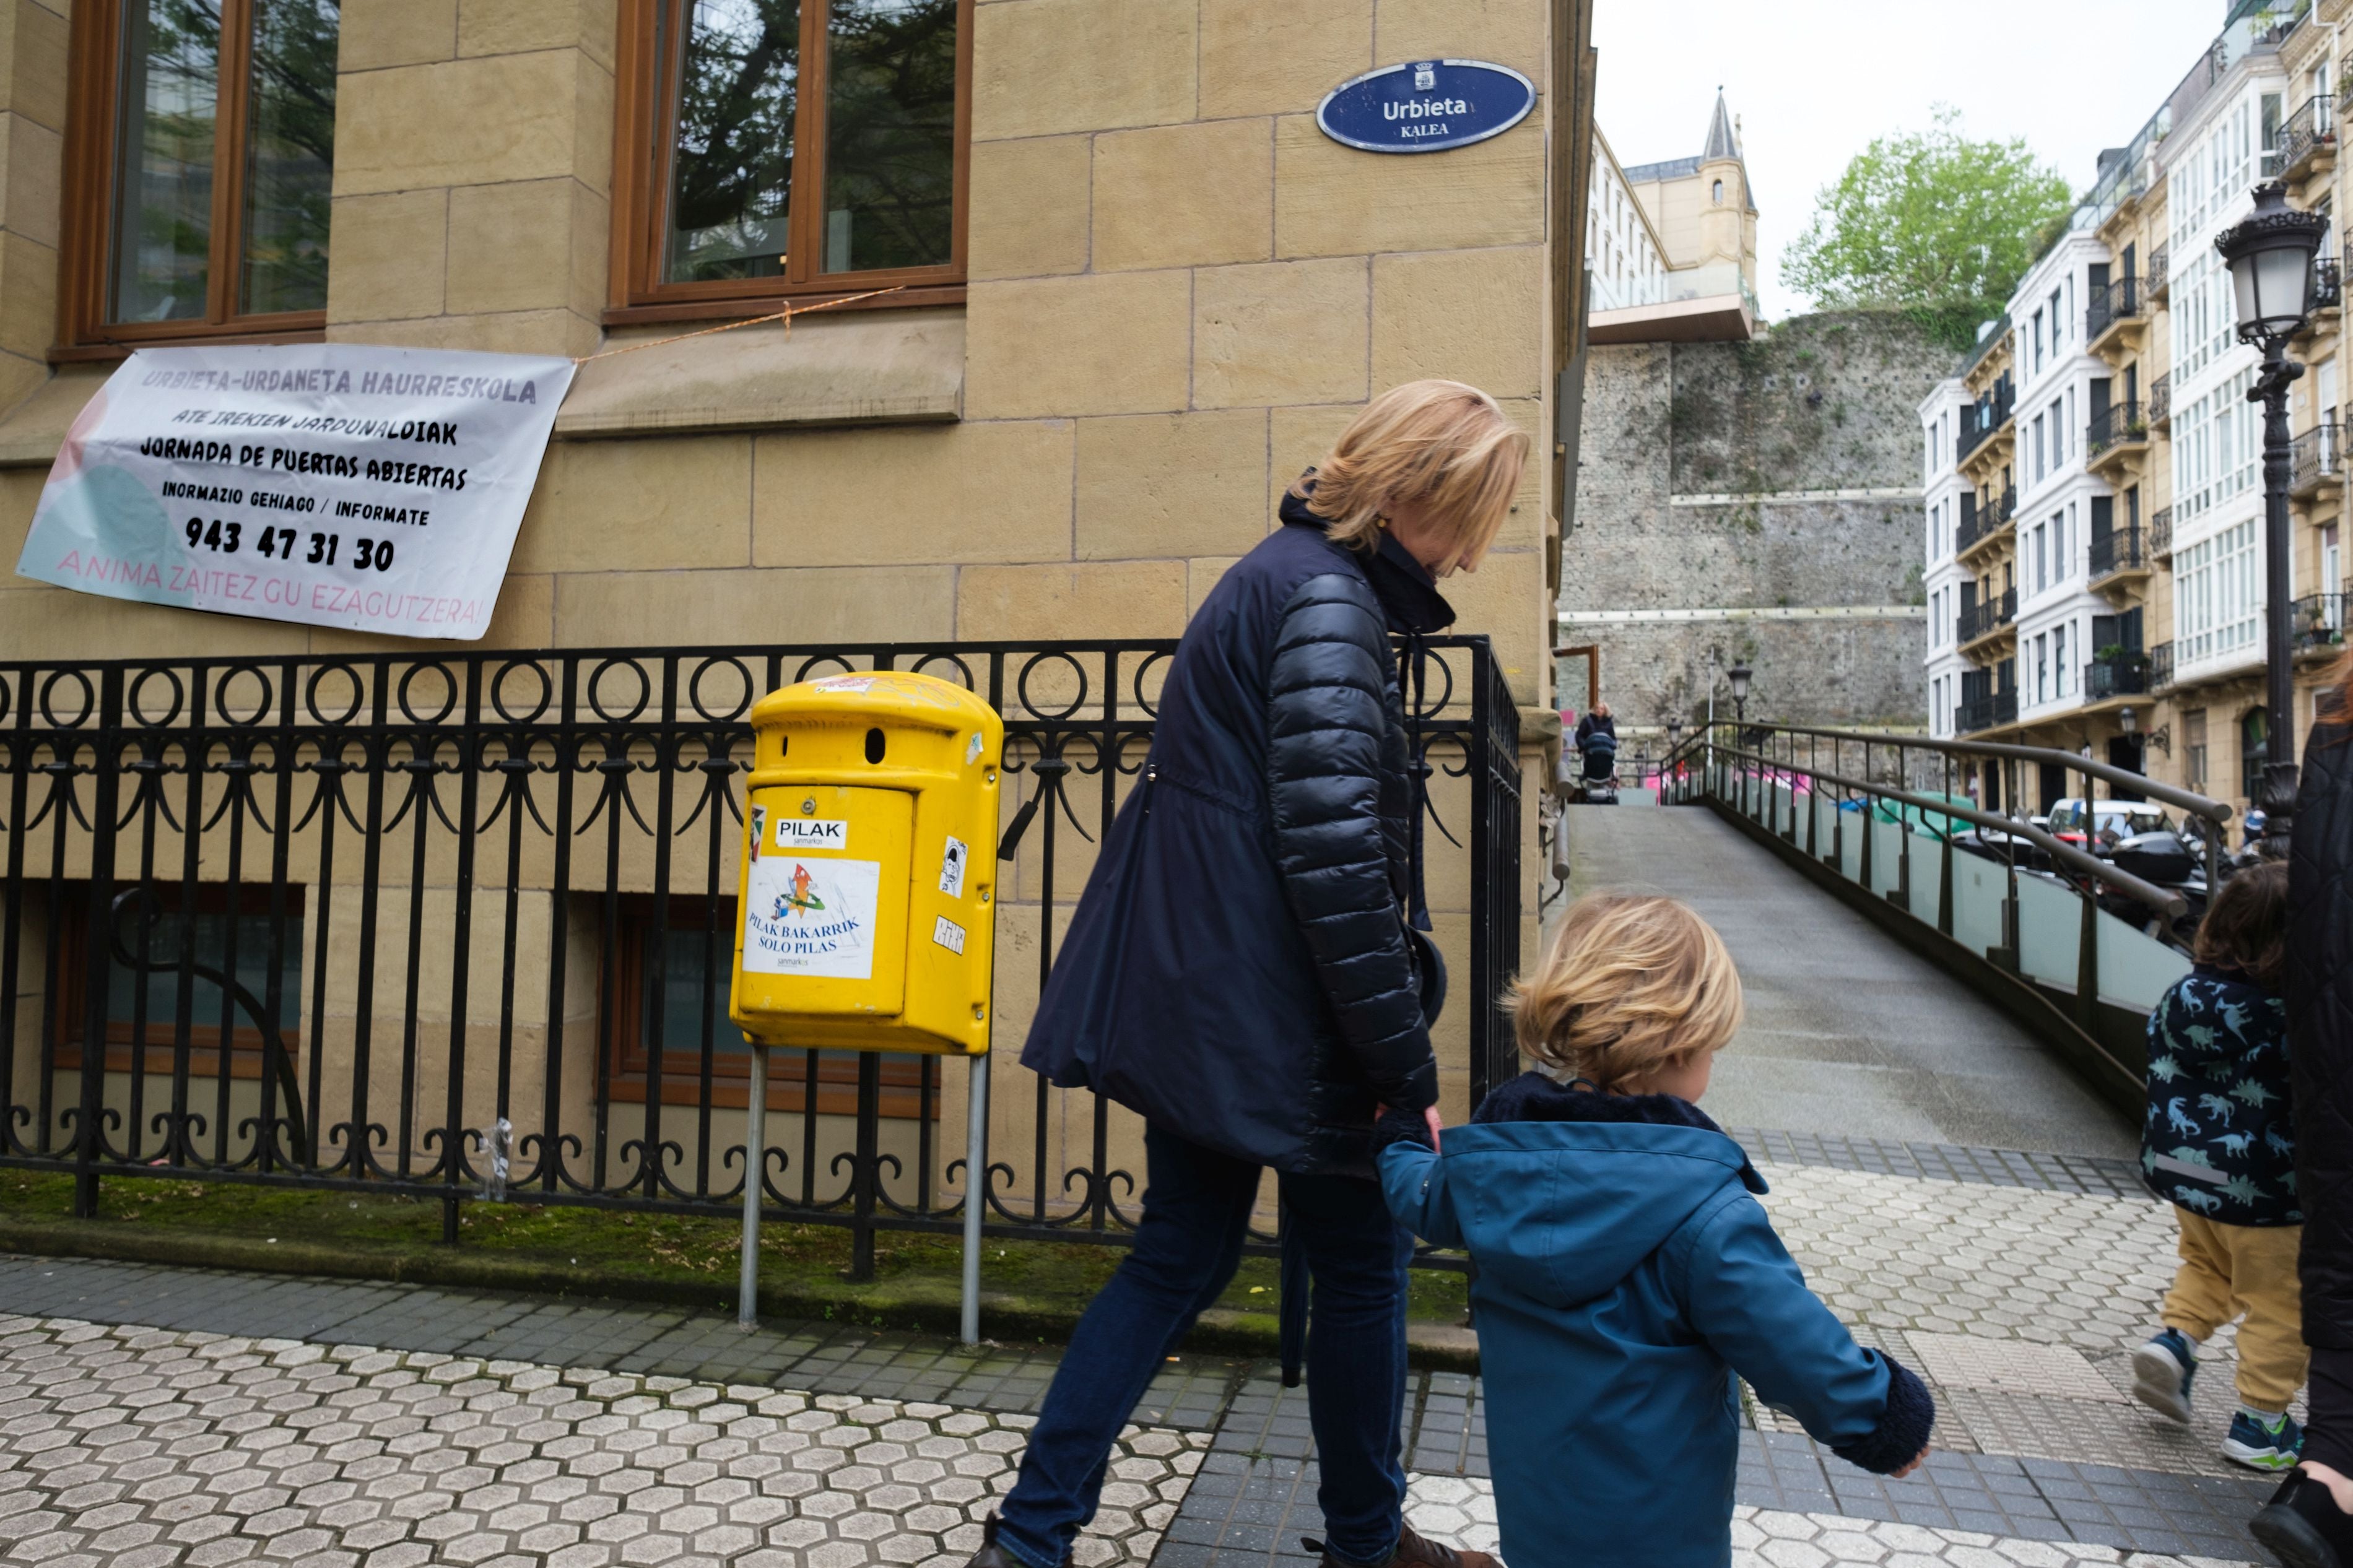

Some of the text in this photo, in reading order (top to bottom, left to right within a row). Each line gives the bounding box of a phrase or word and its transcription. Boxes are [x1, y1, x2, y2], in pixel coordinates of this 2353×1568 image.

[1383, 98, 1467, 120] Urbieta
[1401, 123, 1449, 137] KALEA
[142, 370, 536, 404] URBIETA-URDANETA HAURRESKOLA
[172, 409, 457, 446] ATE IREKIEN JARDUNALDIAK
[141, 437, 468, 491] JORNADA DE PUERTAS ABIERTAS
[163, 482, 429, 526] INORMAZIO GEHIAGO / INFORMATE
[186, 518, 394, 571] 943 47 31 30
[56, 550, 484, 625] ANIMA ZAITEZ GU EZAGUTZERA!
[780, 822, 840, 837] PILAK
[749, 912, 861, 938] PILAK BAKARRIK
[759, 937, 837, 954] SOLO PILAS
